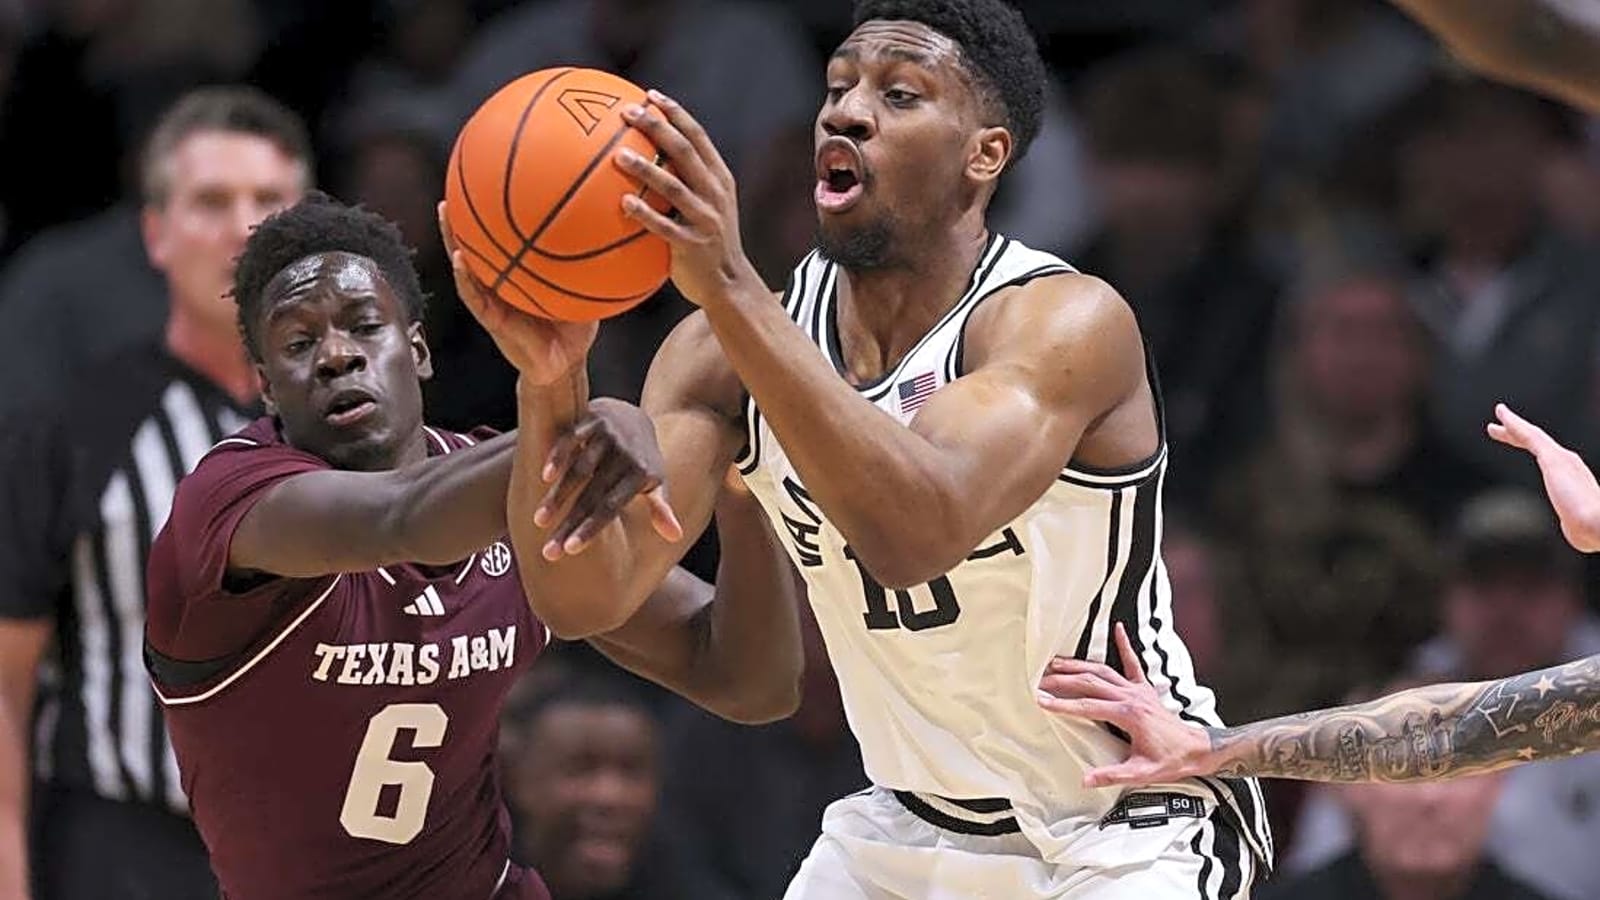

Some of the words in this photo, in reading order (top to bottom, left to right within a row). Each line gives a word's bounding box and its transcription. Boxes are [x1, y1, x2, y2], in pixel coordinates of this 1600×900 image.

[481, 542, 511, 576] SEC
[312, 642, 440, 686] TEXAS
[448, 625, 516, 679] A&M
[339, 703, 449, 845] 6
[1172, 798, 1190, 809] 50
